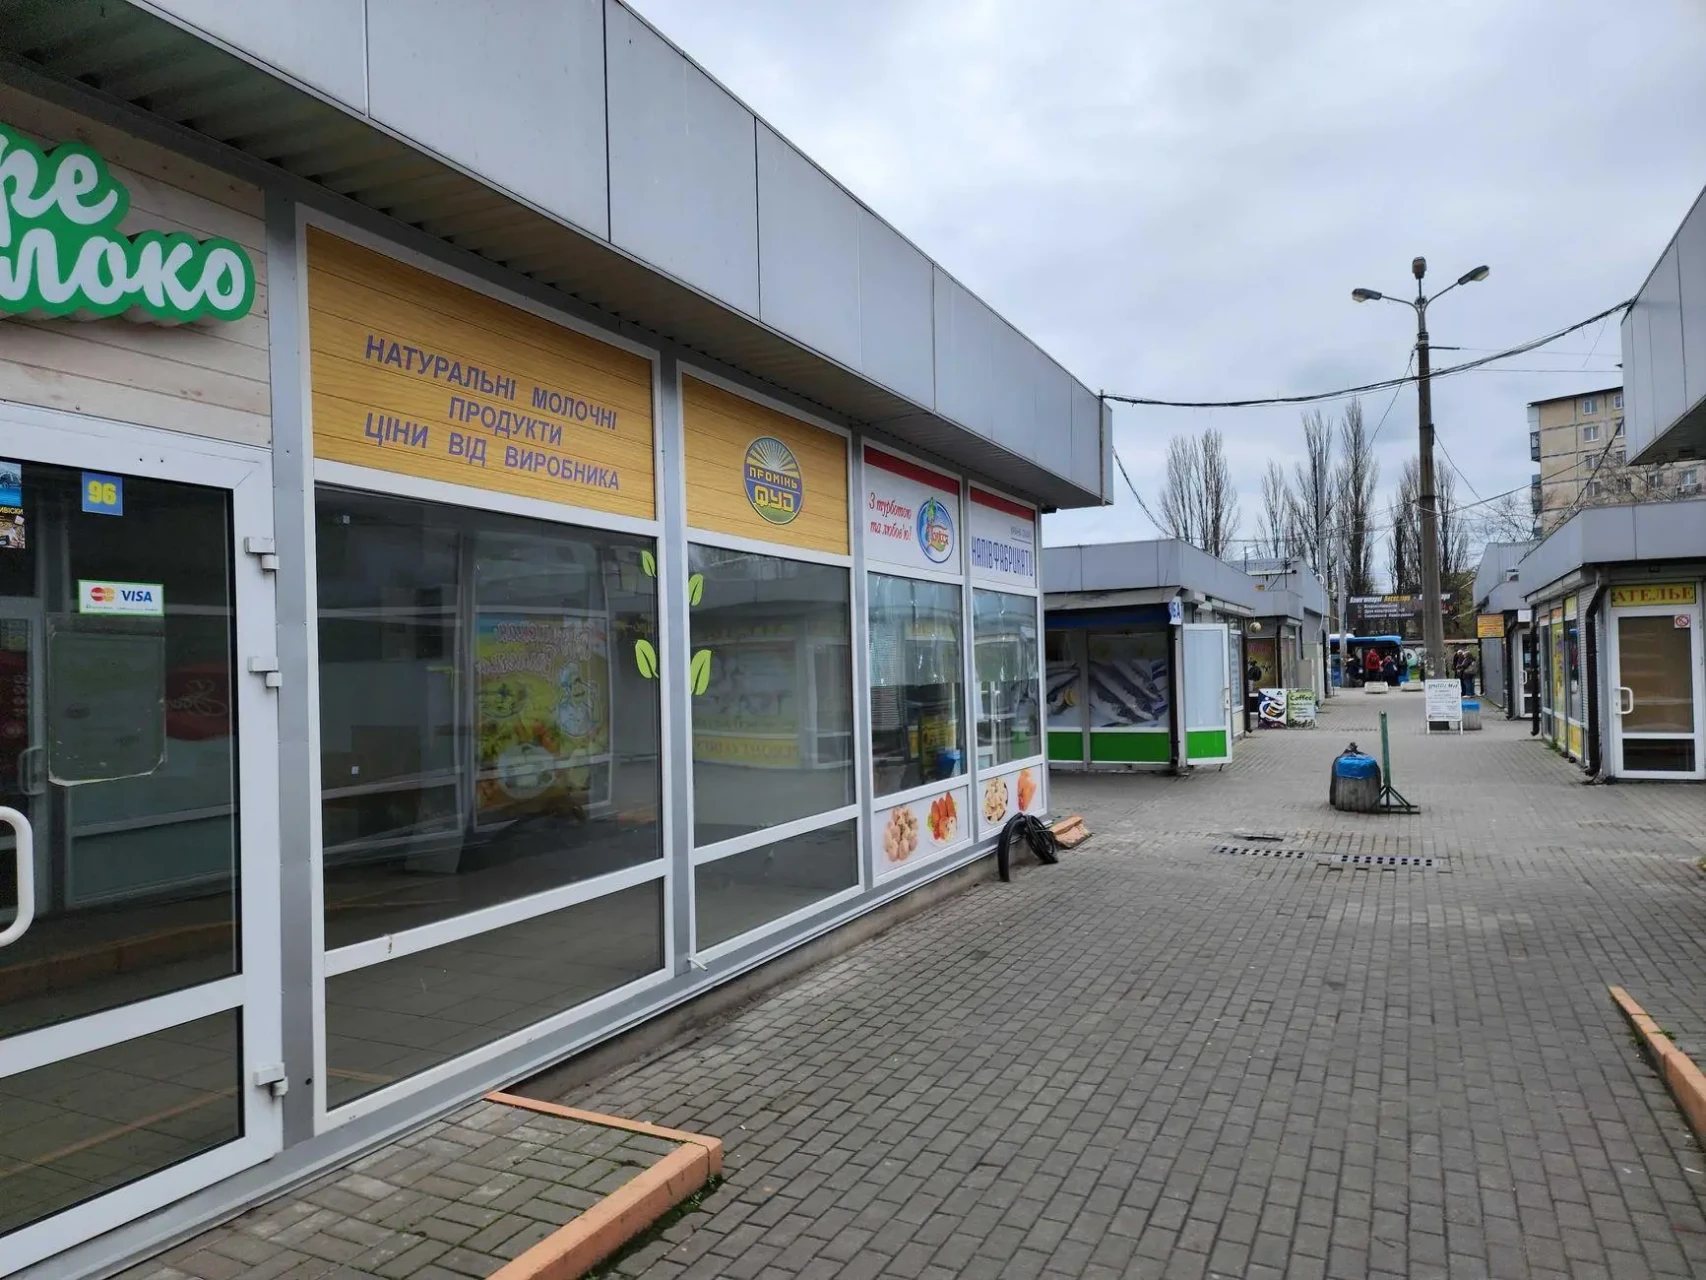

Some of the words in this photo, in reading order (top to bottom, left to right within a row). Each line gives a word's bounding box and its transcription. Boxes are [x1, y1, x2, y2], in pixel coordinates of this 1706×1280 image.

[0, 134, 118, 247] ре
[365, 334, 516, 401] НАТУРАЛЬНІ
[532, 386, 617, 430] МОЛОЧНІ
[449, 396, 563, 446] ПРОДУКТИ
[364, 412, 429, 449] ЦІНИ
[448, 432, 487, 468] ВІД
[504, 445, 620, 490] ВИРОБНИКА
[88, 480, 117, 505] 96
[749, 466, 797, 489] ПРОМІНЬ
[870, 521, 882, 533] та
[971, 536, 1034, 577] НАПІВФАБРИКАТИ
[121, 590, 153, 602] VISA
[1616, 587, 1693, 602] АТЕЛЬЕ
